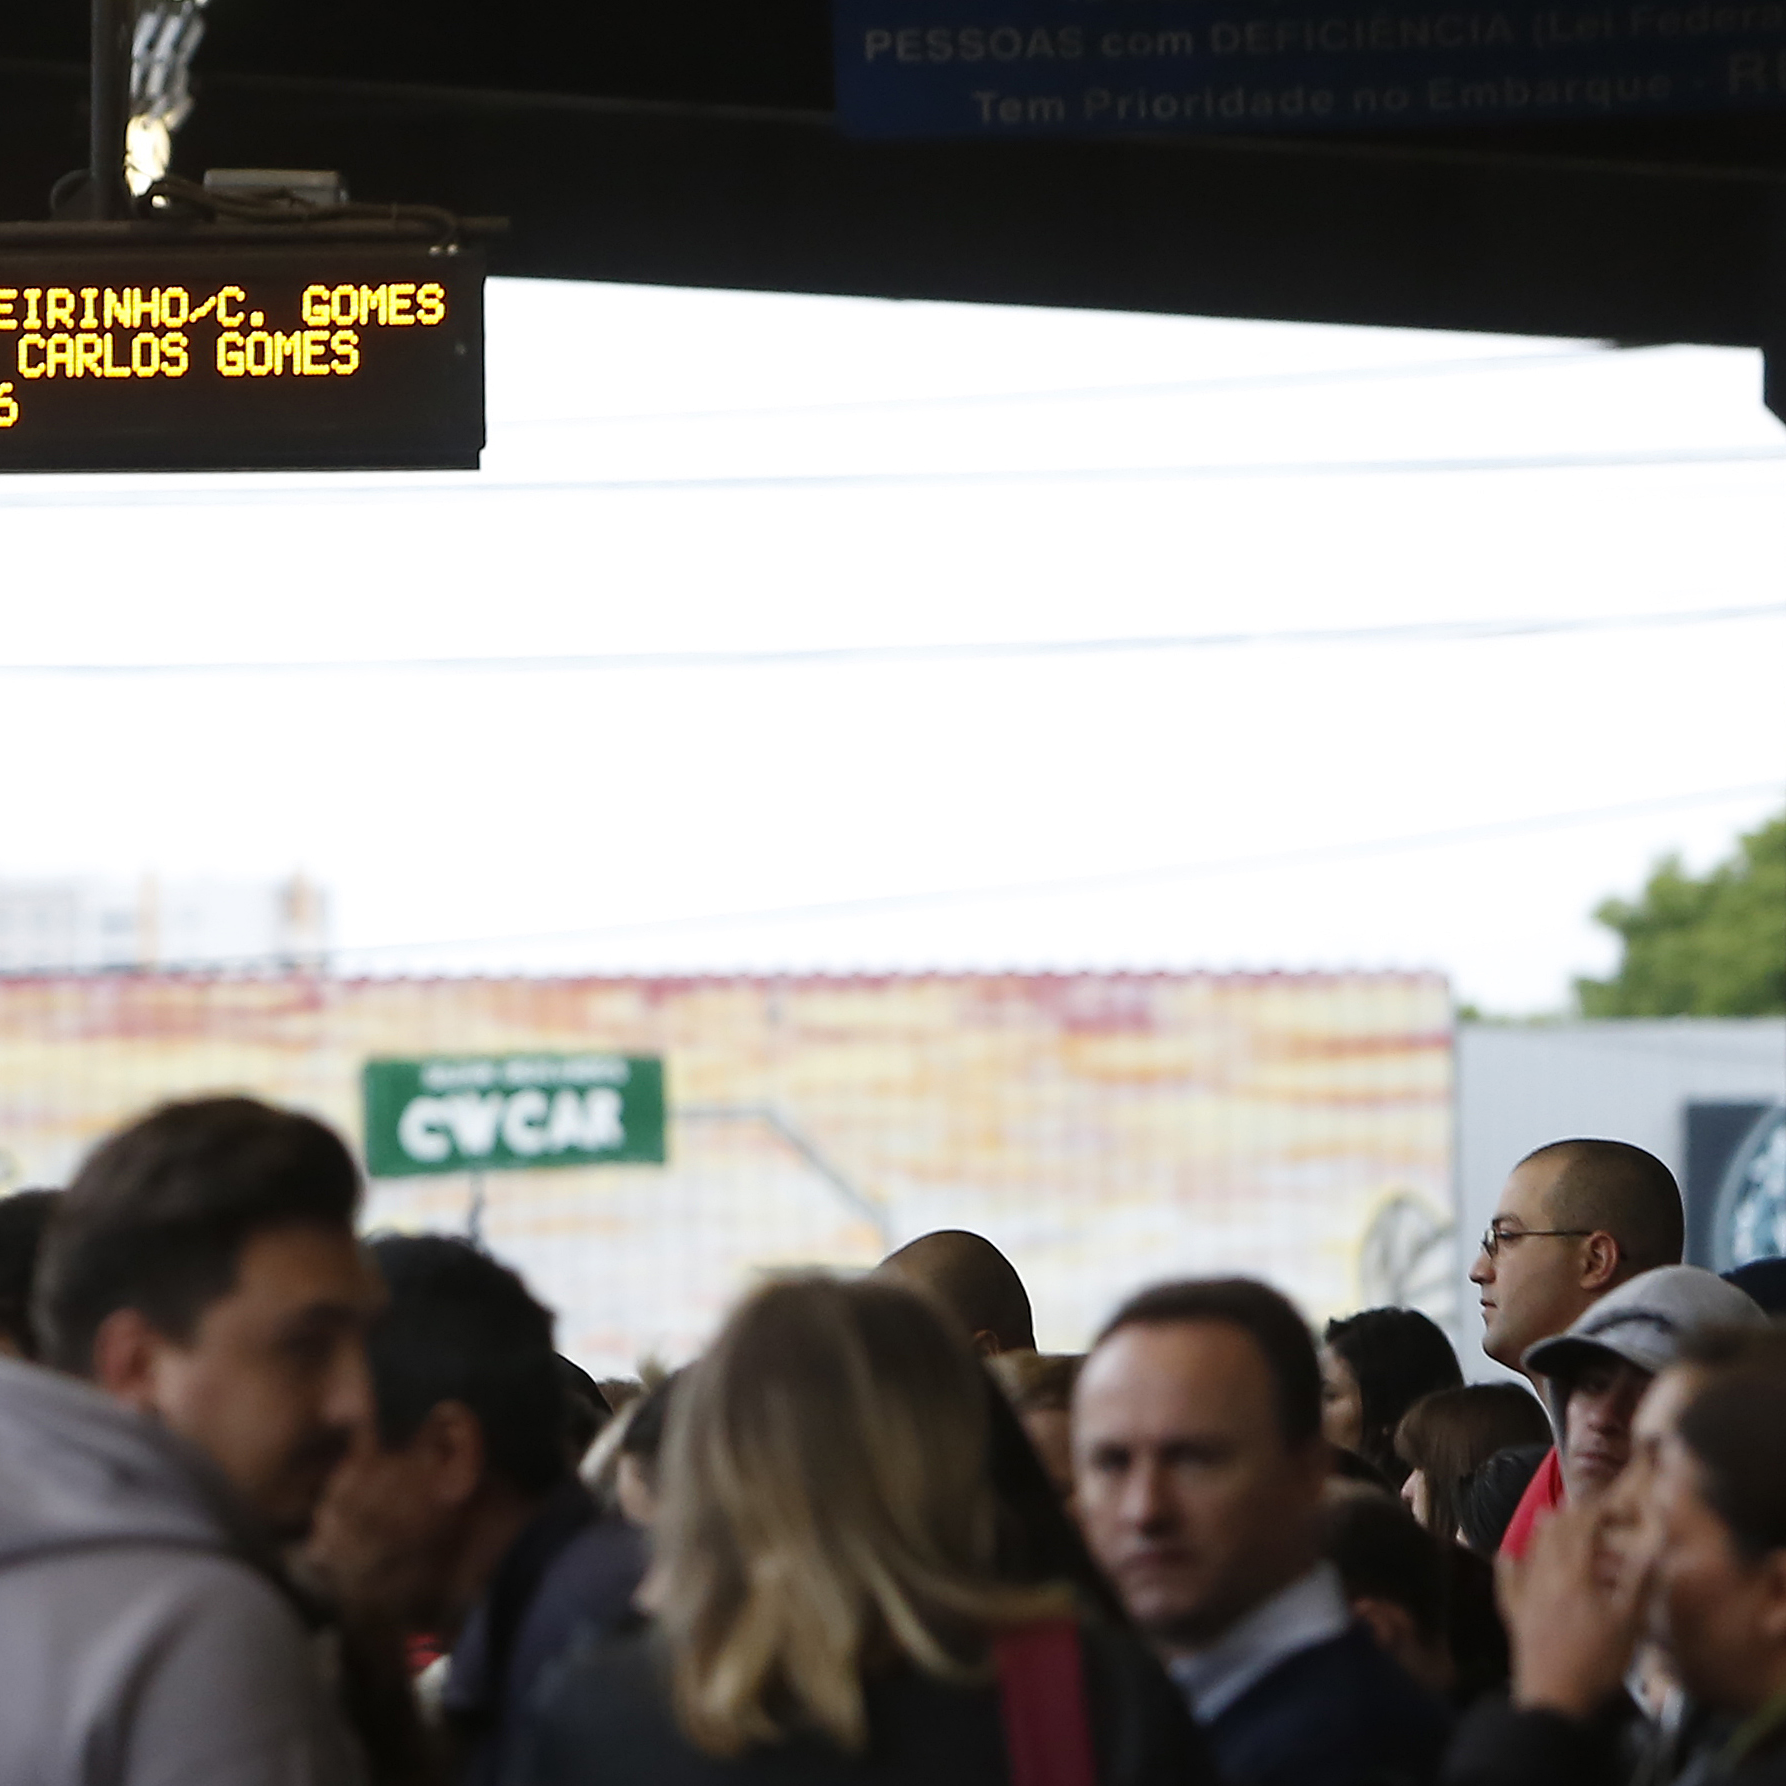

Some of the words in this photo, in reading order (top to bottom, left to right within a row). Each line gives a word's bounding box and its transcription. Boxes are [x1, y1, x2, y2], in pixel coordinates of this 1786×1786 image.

[864, 25, 1084, 63] PESSOAS
[1101, 29, 1194, 58] com
[971, 89, 1066, 124] Tem
[1083, 84, 1335, 120] Prioridade
[1352, 86, 1410, 114] no
[1427, 73, 1673, 111] Embarque
[301, 281, 447, 328] GOMES
[16, 330, 190, 379] CARLOS
[215, 329, 362, 378] GOMES
